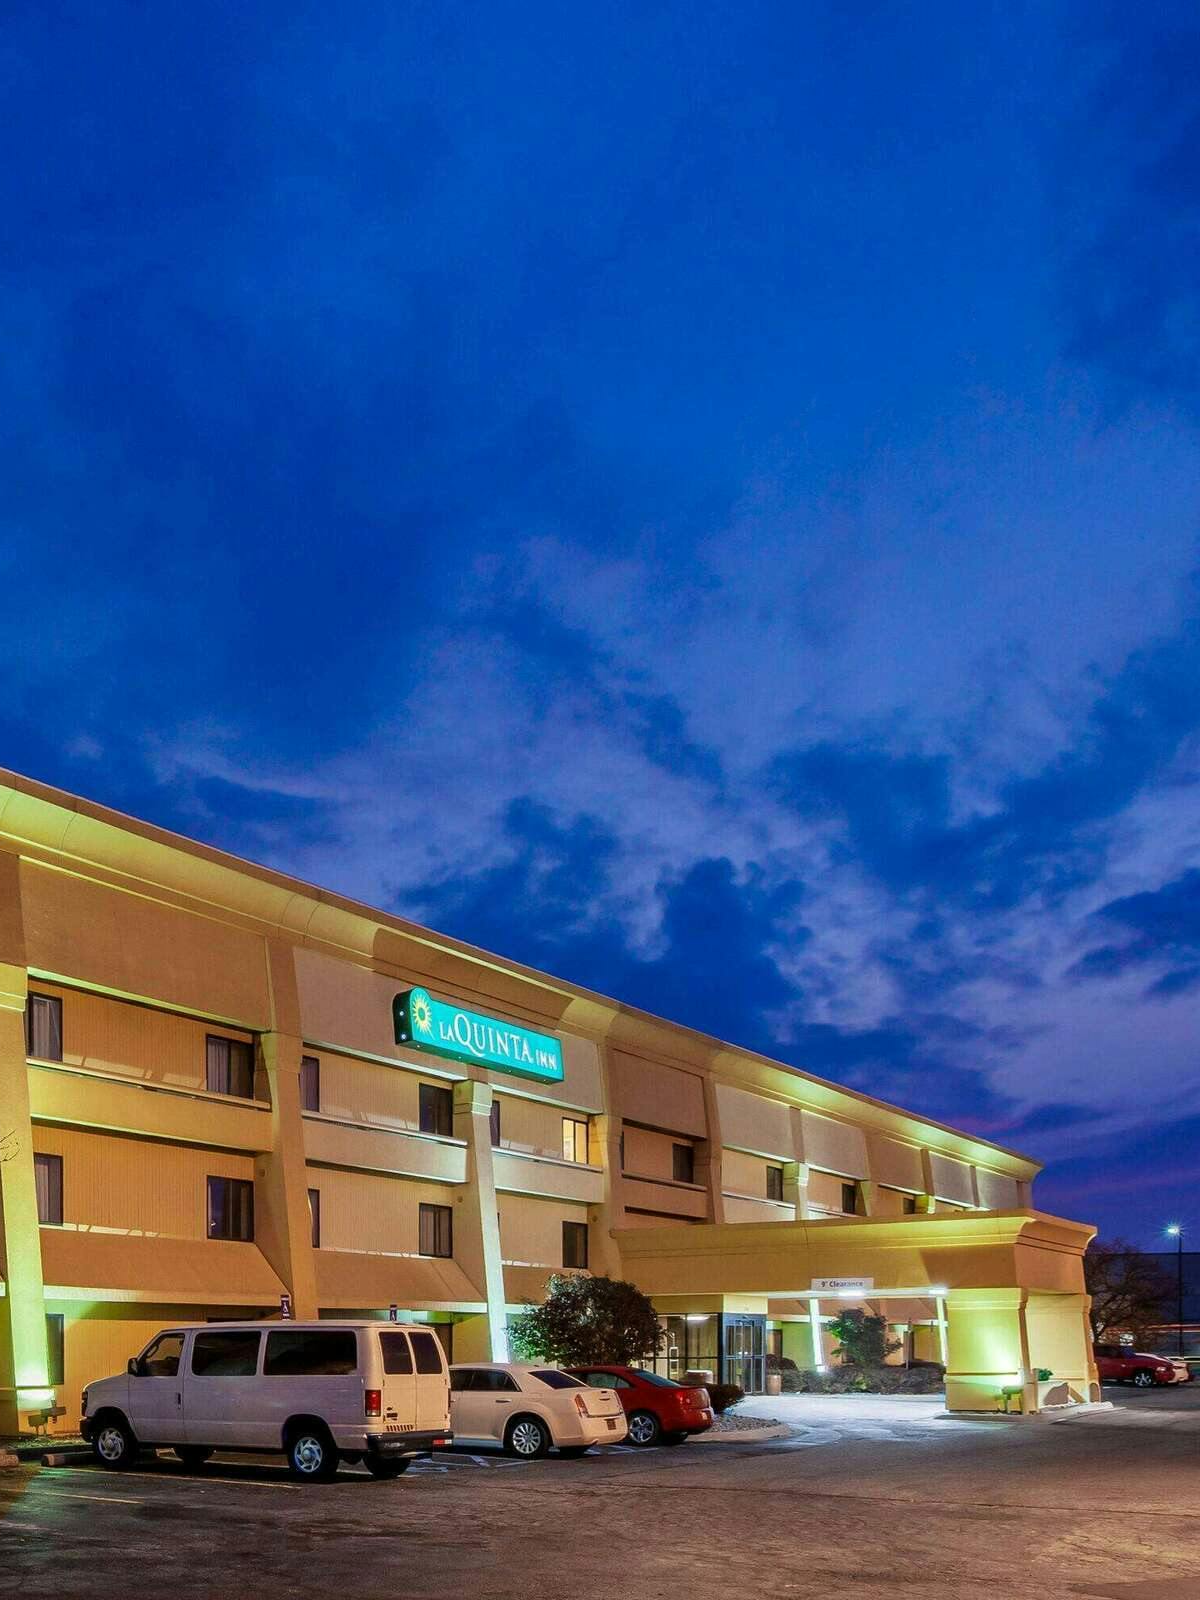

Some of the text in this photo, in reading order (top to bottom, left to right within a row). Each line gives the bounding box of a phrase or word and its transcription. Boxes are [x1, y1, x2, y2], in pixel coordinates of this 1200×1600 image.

[439, 1013, 557, 1071] LA QUINTA INN
